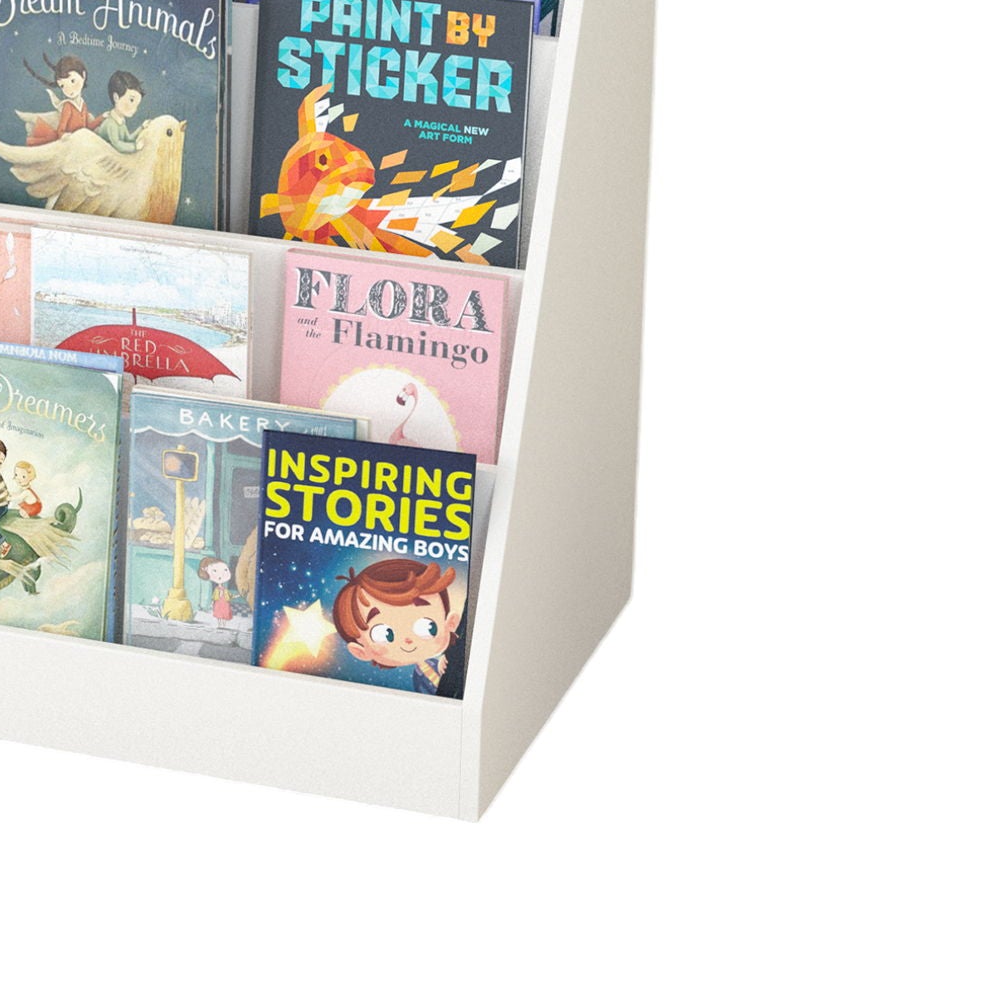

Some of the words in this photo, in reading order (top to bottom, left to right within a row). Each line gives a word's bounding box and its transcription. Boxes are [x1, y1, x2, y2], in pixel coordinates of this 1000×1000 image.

[446, 10, 496, 48] BY
[56, 30, 66, 46] A
[69, 30, 105, 47] Bedtime
[106, 34, 138, 58] Journey
[276, 35, 513, 113] STICKER
[403, 119, 412, 128] A
[413, 119, 461, 134] MAGICAL
[463, 126, 490, 137] NEW
[418, 130, 441, 141] ART
[442, 133, 473, 145] FORM
[292, 266, 495, 335] FLORA
[130, 328, 148, 338] THE
[297, 316, 319, 326] and
[121, 337, 157, 354] RED
[305, 330, 322, 339] the
[332, 317, 489, 370] Flamingo
[89, 347, 190, 373] BRELLA
[179, 408, 291, 433] BAKERY
[267, 448, 473, 501] INSPIRING
[265, 481, 472, 541] STORIES
[264, 520, 305, 542] FOR
[309, 527, 409, 555] AMAZING
[413, 538, 470, 562] BOYS
